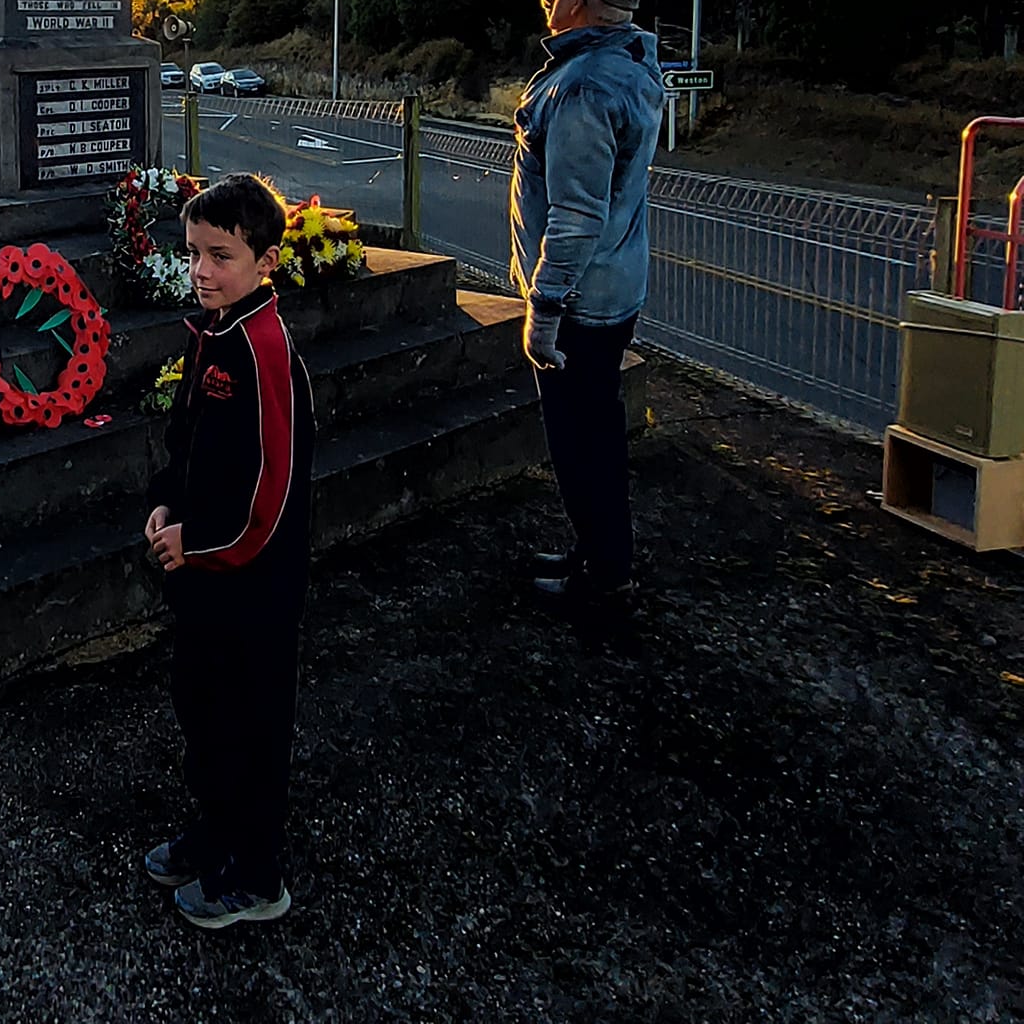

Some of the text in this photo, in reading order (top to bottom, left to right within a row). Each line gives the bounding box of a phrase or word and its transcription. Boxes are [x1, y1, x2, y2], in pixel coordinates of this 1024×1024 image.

[22, 1, 49, 10] THOSE
[56, 1, 75, 10] WHO
[83, 1, 101, 10] FELL
[32, 17, 110, 29] WORLD WAR II
[93, 78, 128, 89] MILLER
[91, 98, 128, 110] COOPER
[90, 119, 128, 132] SEATON
[80, 143, 87, 153] B
[90, 140, 128, 153] COUPER
[99, 160, 128, 172] SMITH
